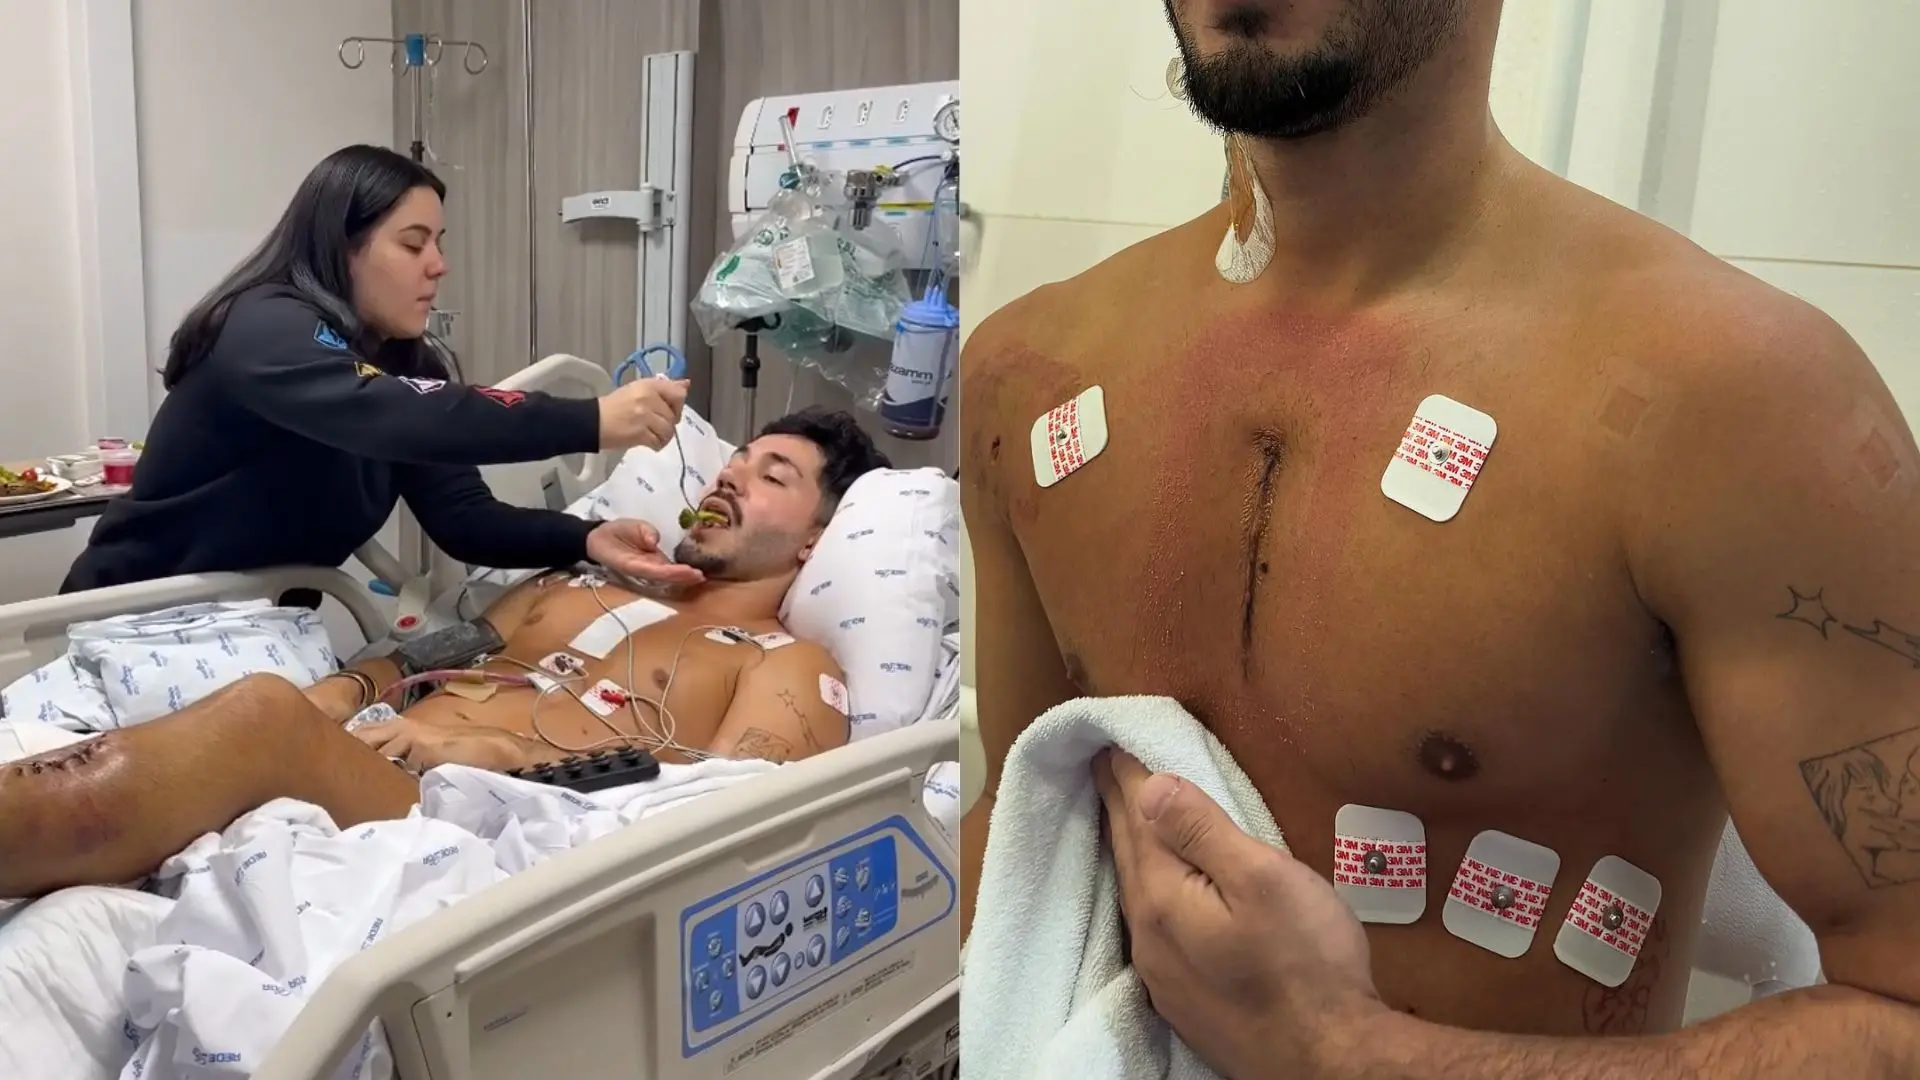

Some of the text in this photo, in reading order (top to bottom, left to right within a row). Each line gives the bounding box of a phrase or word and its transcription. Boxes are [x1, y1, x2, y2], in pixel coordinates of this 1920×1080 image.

[1413, 423, 1425, 433] 3M
[1426, 428, 1440, 439] 3M
[1440, 435, 1454, 446] 3M
[1455, 441, 1470, 452] 3M
[1471, 448, 1487, 459] 3M
[1414, 436, 1427, 446] 3M
[1449, 450, 1457, 459] M
[1458, 456, 1473, 467] 3M
[1474, 463, 1481, 471] 3
[1402, 443, 1476, 481] 3M 3M 3M 3M
[1434, 469, 1446, 479] 3M
[1449, 476, 1463, 487] 3M
[1335, 838, 1341, 846] M
[1344, 840, 1357, 850] 3M
[1360, 843, 1376, 851] 3M
[1378, 844, 1393, 853] 3M
[1336, 850, 1421, 865] 3M 3M 3M 3M
[1335, 862, 1341, 870] M
[1344, 864, 1357, 873] 3M
[1360, 866, 1368, 874] 3
[1336, 874, 1349, 883] 3M
[1352, 876, 1366, 885] 3M
[1370, 878, 1384, 886] 3M
[1388, 879, 1403, 887] 3M
[1577, 892, 1646, 933] M 3M 3 3M 3
[1583, 881, 1650, 922] 3M 3M 3M 3M 3M
[1566, 913, 1573, 921] M
[1574, 917, 1589, 930] 3M
[1589, 926, 1603, 937] 3M
[1603, 933, 1617, 945] 3M
[1617, 941, 1629, 952] 3M
[1572, 902, 1639, 943] 3M 3M 3M 3M
